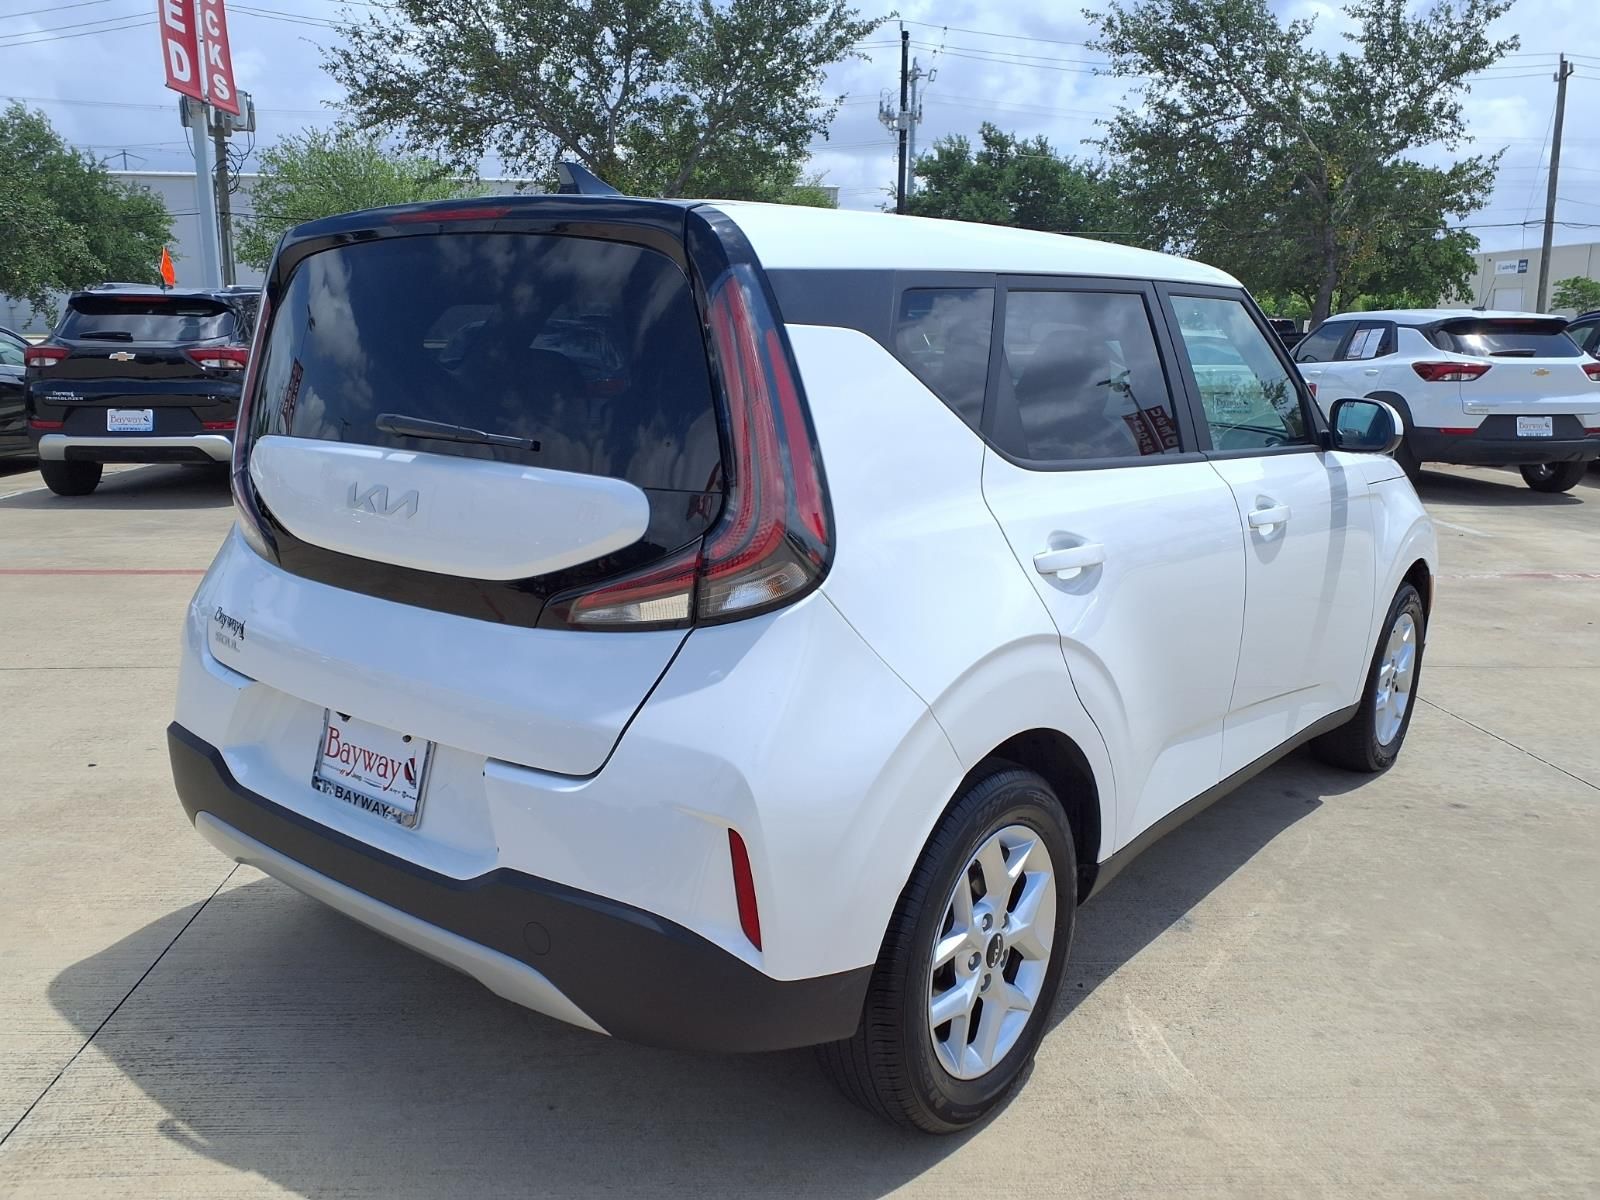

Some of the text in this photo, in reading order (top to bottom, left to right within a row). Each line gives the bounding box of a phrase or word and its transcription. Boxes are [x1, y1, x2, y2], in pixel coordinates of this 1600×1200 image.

[205, 0, 230, 100] CKS
[214, 606, 242, 637] Bayway
[324, 726, 402, 791] Bayway
[334, 785, 388, 818] BAYWAY
